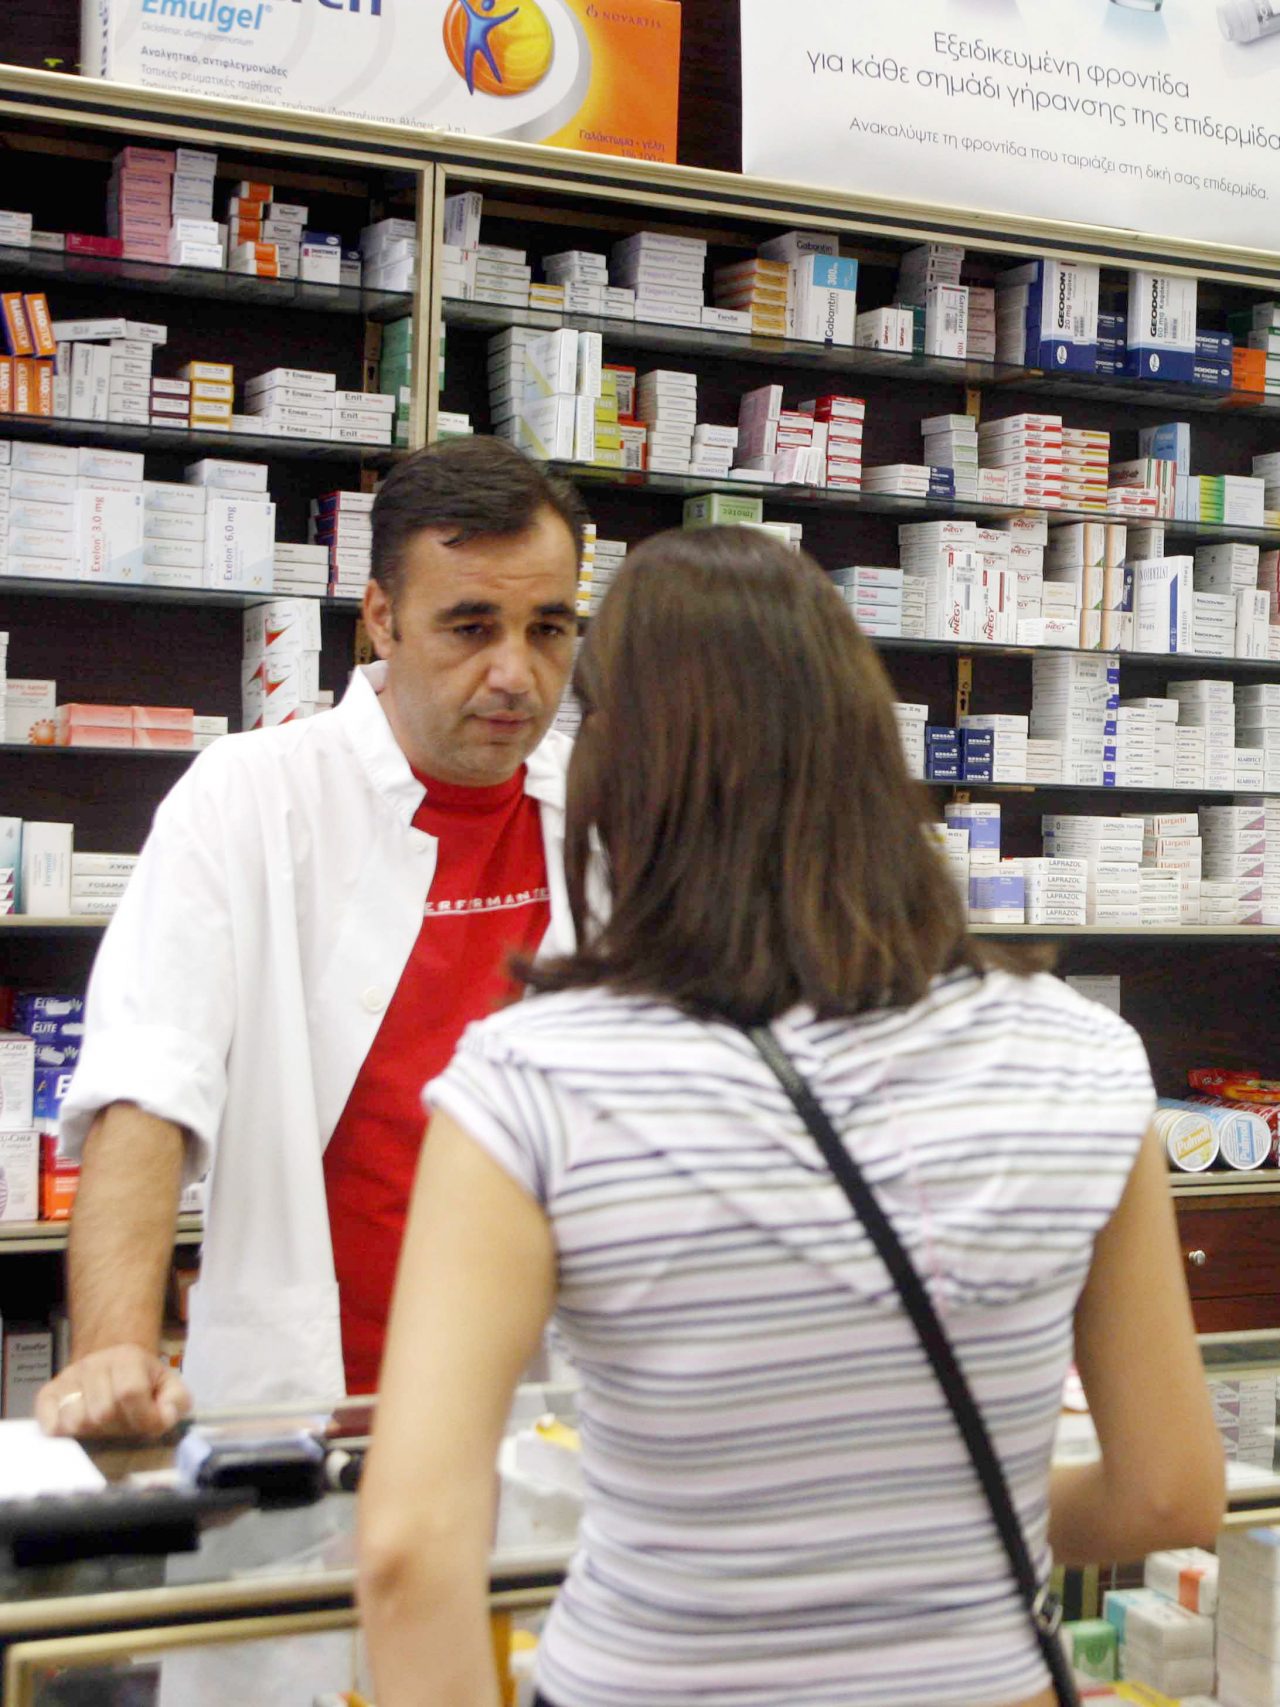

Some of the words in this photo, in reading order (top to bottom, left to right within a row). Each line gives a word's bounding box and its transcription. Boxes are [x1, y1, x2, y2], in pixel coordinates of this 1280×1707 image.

[933, 31, 1080, 83] Εξειδικευμένη
[1087, 64, 1190, 99] φροντίδα
[806, 50, 843, 74] για
[851, 54, 910, 84] κάθε
[917, 70, 1001, 100] σημάδι
[1006, 82, 1126, 127] γήρανσης
[1132, 106, 1168, 134] της
[849, 117, 940, 145] Ανακαλύψτε
[943, 134, 959, 149] τη
[961, 137, 1027, 158] φροντίδα
[1030, 147, 1058, 163] που
[1061, 151, 1116, 174] ταιριάζει
[1119, 162, 1143, 180] στη
[1146, 164, 1171, 185] δική
[1174, 172, 1201, 190] σας
[1203, 177, 1270, 201] επιδερμίδα.
[825, 292, 836, 338] Gabantin
[1057, 271, 1067, 329] GEODON
[1150, 278, 1158, 338] GEODON
[344, 393, 362, 401] Enit
[340, 411, 358, 419] Enit
[91, 539, 102, 572] Exelon
[223, 550, 233, 581] Exelon
[953, 600, 961, 635] INEGY
[986, 606, 995, 640] INEGY
[1160, 816, 1187, 826] Largactil
[1164, 838, 1191, 848] Largactil
[32, 1021, 57, 1034] ELITE
